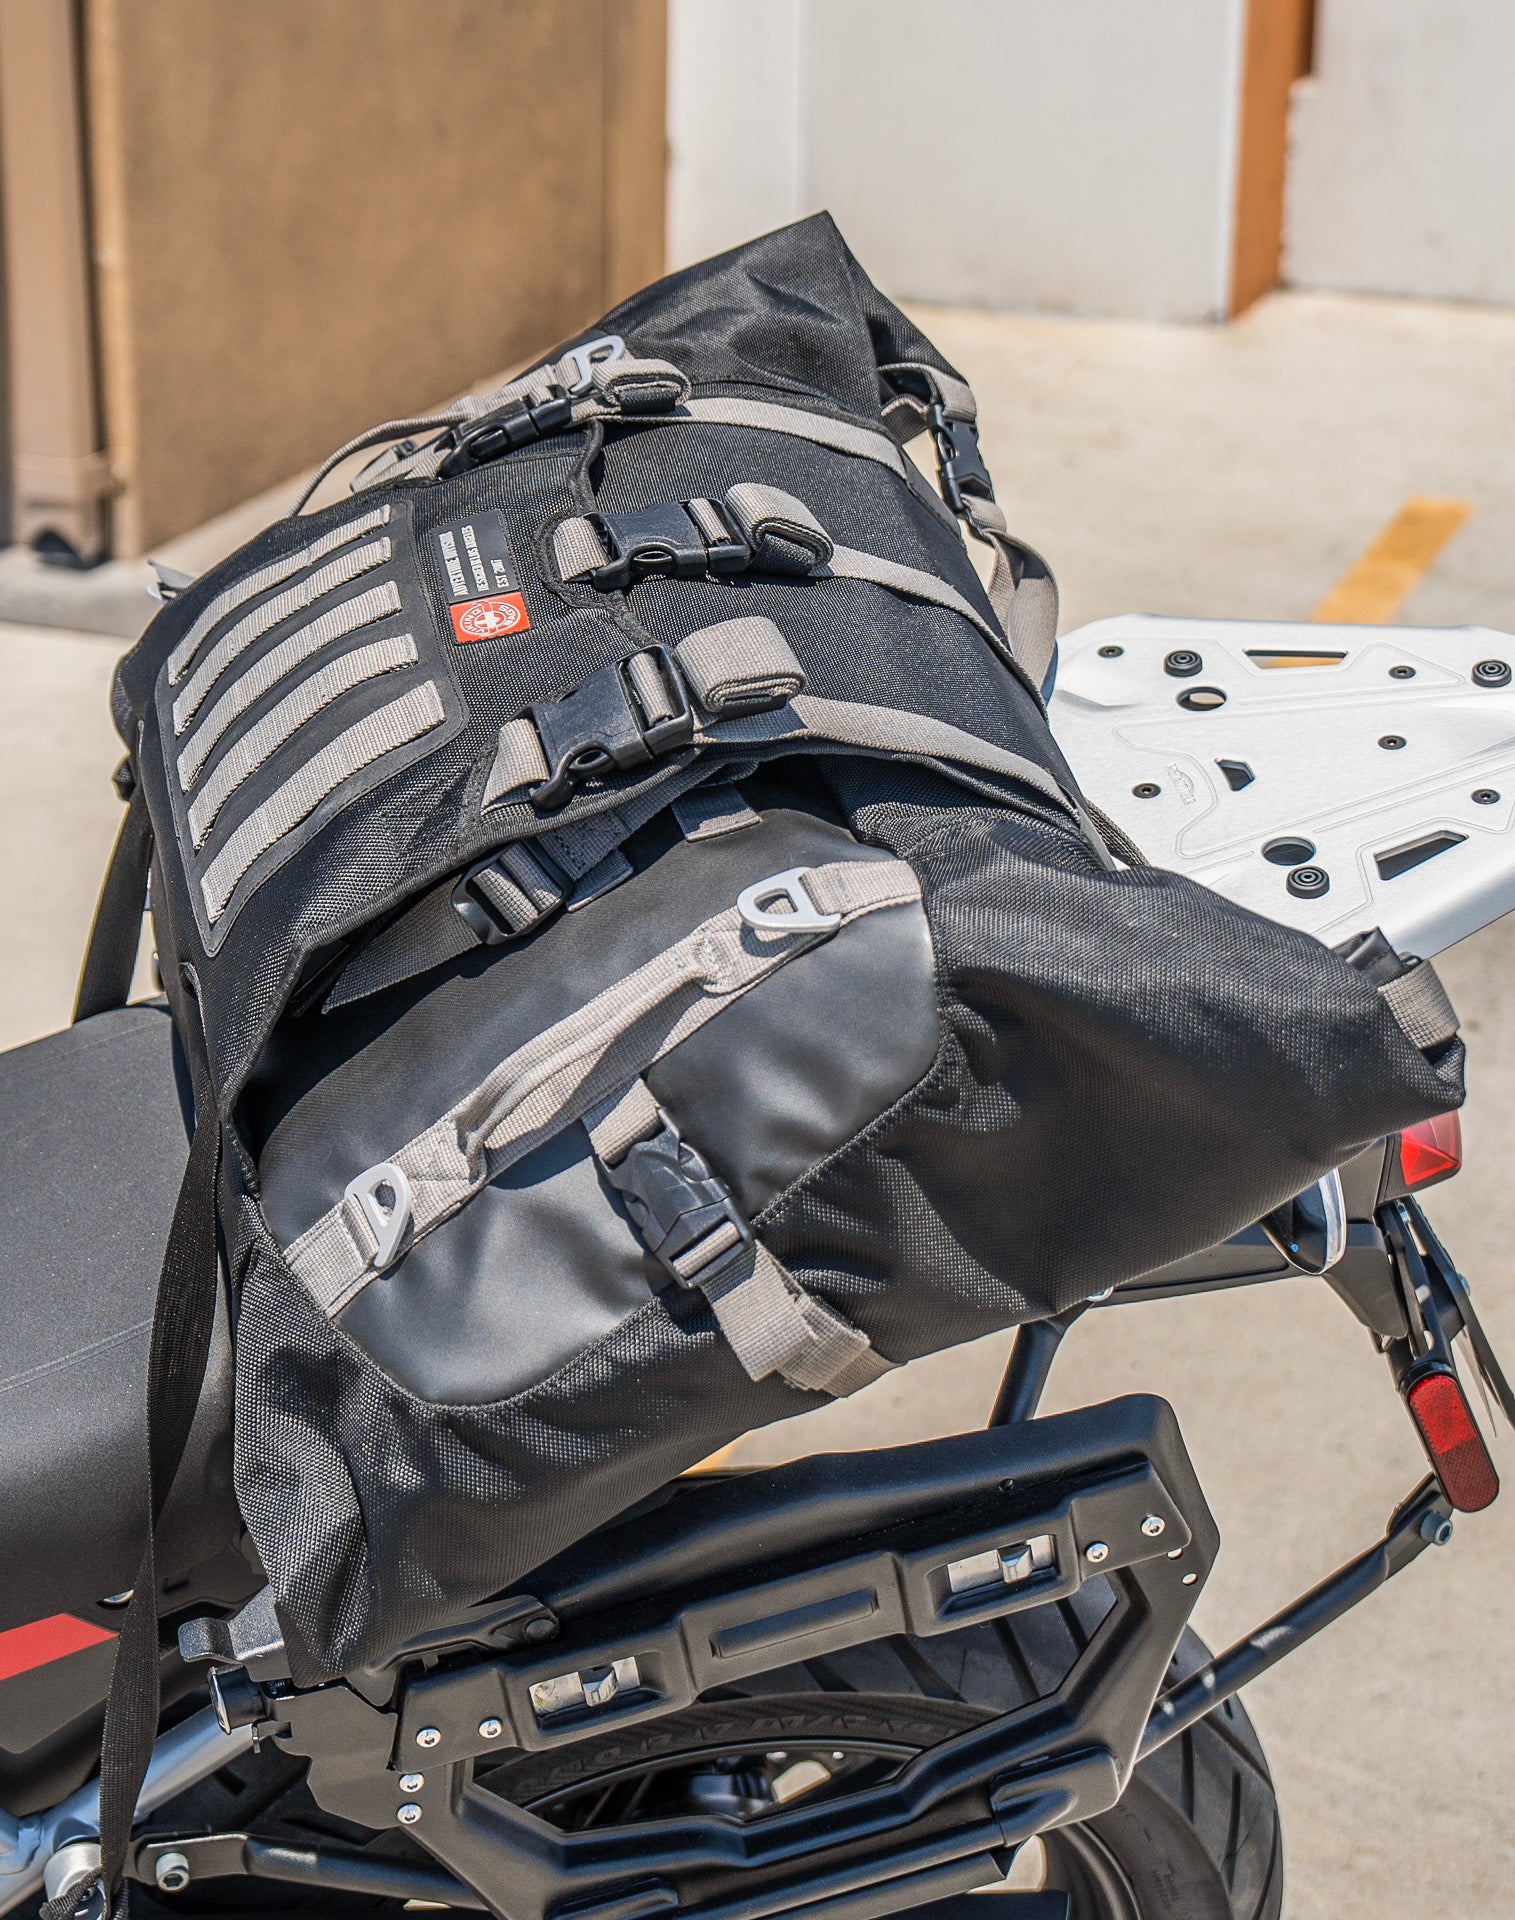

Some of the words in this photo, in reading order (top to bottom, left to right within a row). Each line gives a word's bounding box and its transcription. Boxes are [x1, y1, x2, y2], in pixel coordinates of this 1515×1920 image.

[438, 531, 459, 560] DIVISION
[461, 525, 478, 549] ANGELES
[467, 548, 480, 560] LOS
[445, 557, 469, 597] ADVENTURE
[471, 564, 489, 592] DESIGNED
[464, 608, 485, 634] VIKING
[499, 604, 516, 627] BAGS
